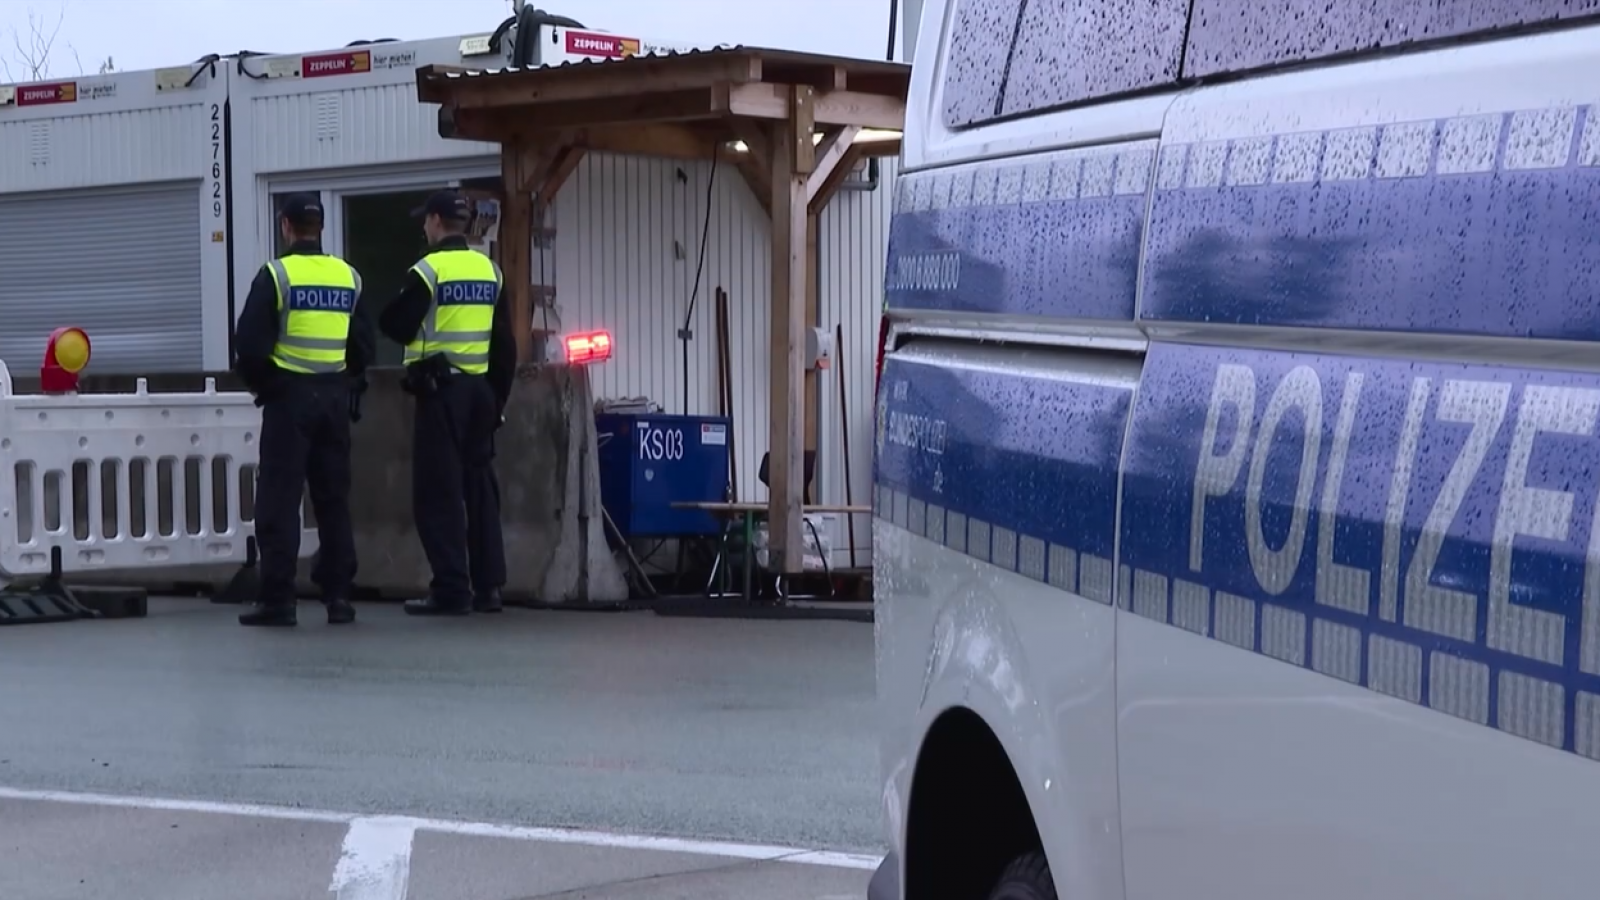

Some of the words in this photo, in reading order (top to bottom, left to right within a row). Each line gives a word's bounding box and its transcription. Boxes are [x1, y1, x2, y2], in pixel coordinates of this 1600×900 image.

[574, 38, 615, 52] ZEPPELIN
[309, 58, 347, 72] ZEPPELIN
[23, 89, 56, 100] ZEPPELIN
[211, 103, 221, 218] 227629
